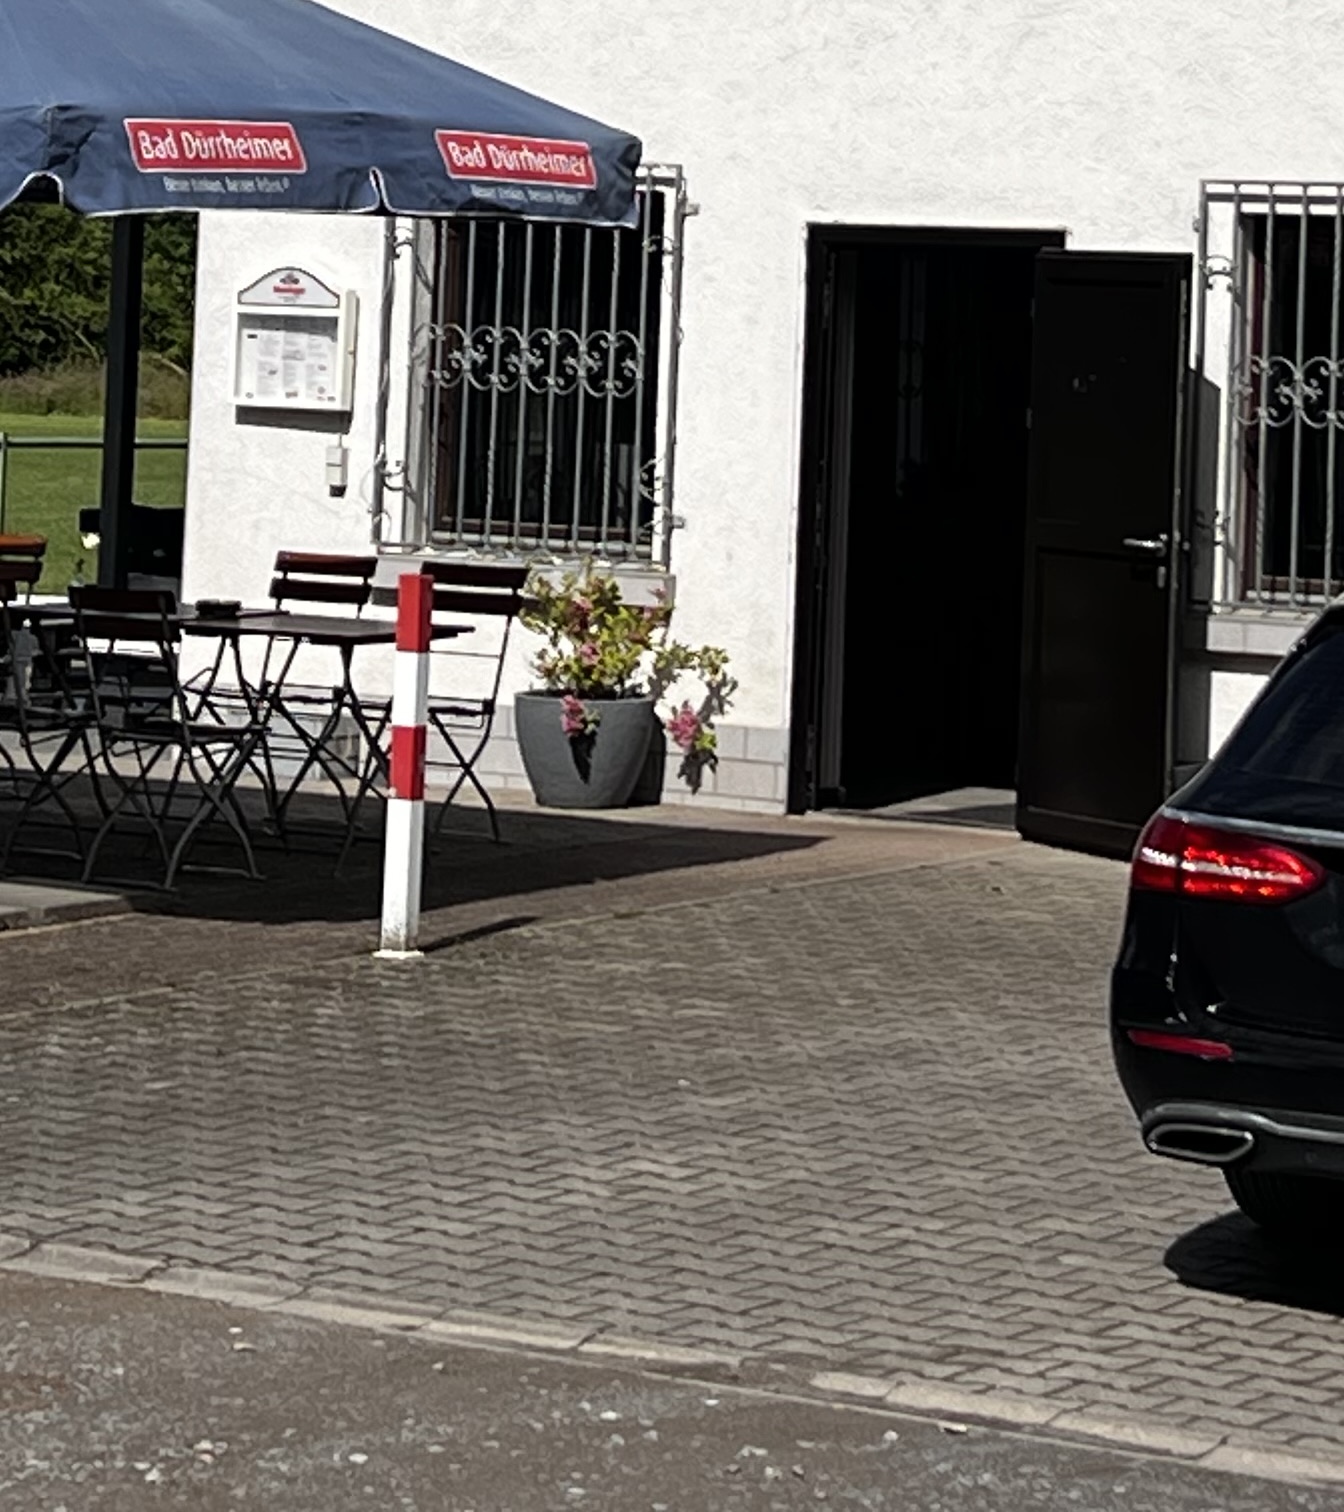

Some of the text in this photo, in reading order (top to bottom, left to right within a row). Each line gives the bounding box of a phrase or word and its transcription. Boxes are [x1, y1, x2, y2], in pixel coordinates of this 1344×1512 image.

[137, 128, 294, 161] Bad Dürrheimer
[446, 140, 587, 177] Bad Dürrheimer
